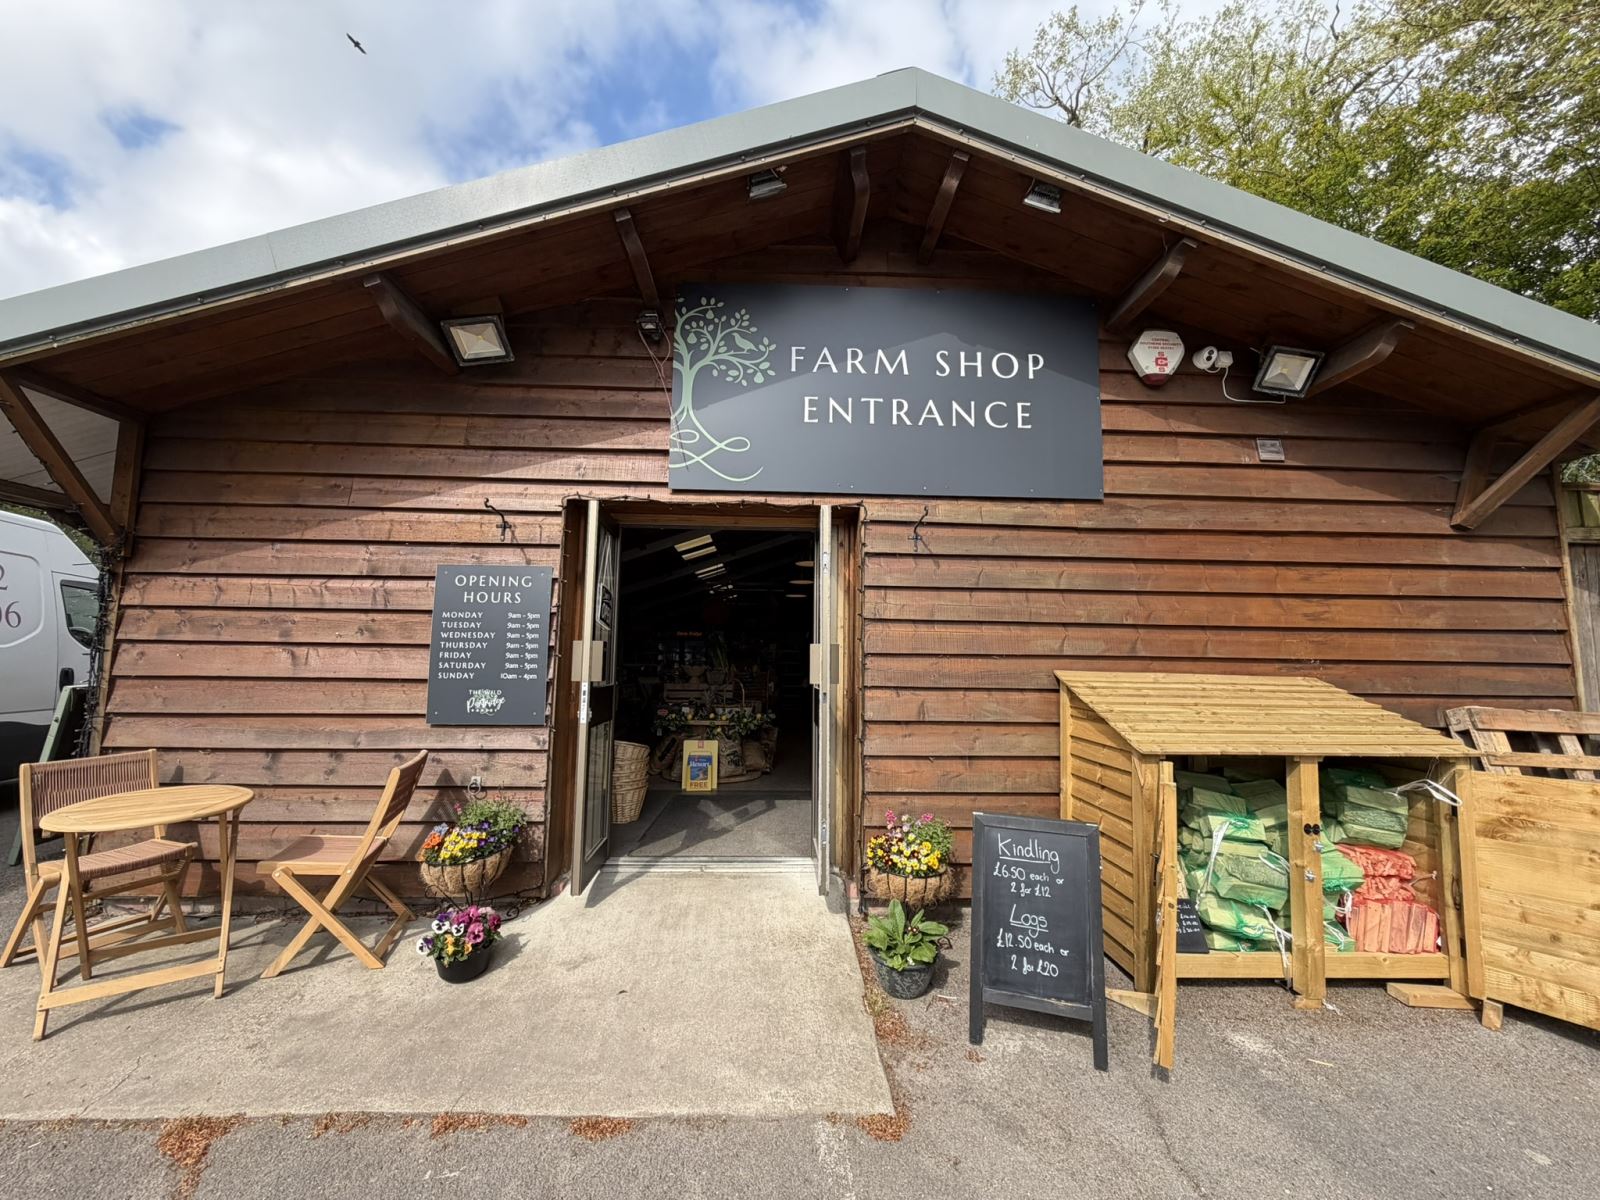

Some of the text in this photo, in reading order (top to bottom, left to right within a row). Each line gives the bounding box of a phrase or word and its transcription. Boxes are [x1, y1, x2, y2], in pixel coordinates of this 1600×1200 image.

[789, 345, 1045, 380] FARM SHOP
[803, 396, 1033, 429] ENTRANCE
[455, 574, 533, 587] OPENING
[463, 591, 521, 604] HOURS
[0, 601, 21, 628] 6
[442, 611, 483, 619] MONDAY
[442, 621, 482, 629] TUESDAY
[441, 631, 496, 639] WEDNESDAY
[526, 633, 539, 641] 5pm
[525, 663, 538, 671] 5pm
[523, 673, 537, 681] 4pm
[998, 833, 1060, 874] Kindling
[993, 862, 1065, 885] £6.50 each or
[1010, 882, 1051, 897] 2 for £12
[1010, 903, 1048, 938] Logs
[997, 928, 1070, 957] £12.50 each or
[1011, 954, 1059, 977] 2 for £20
